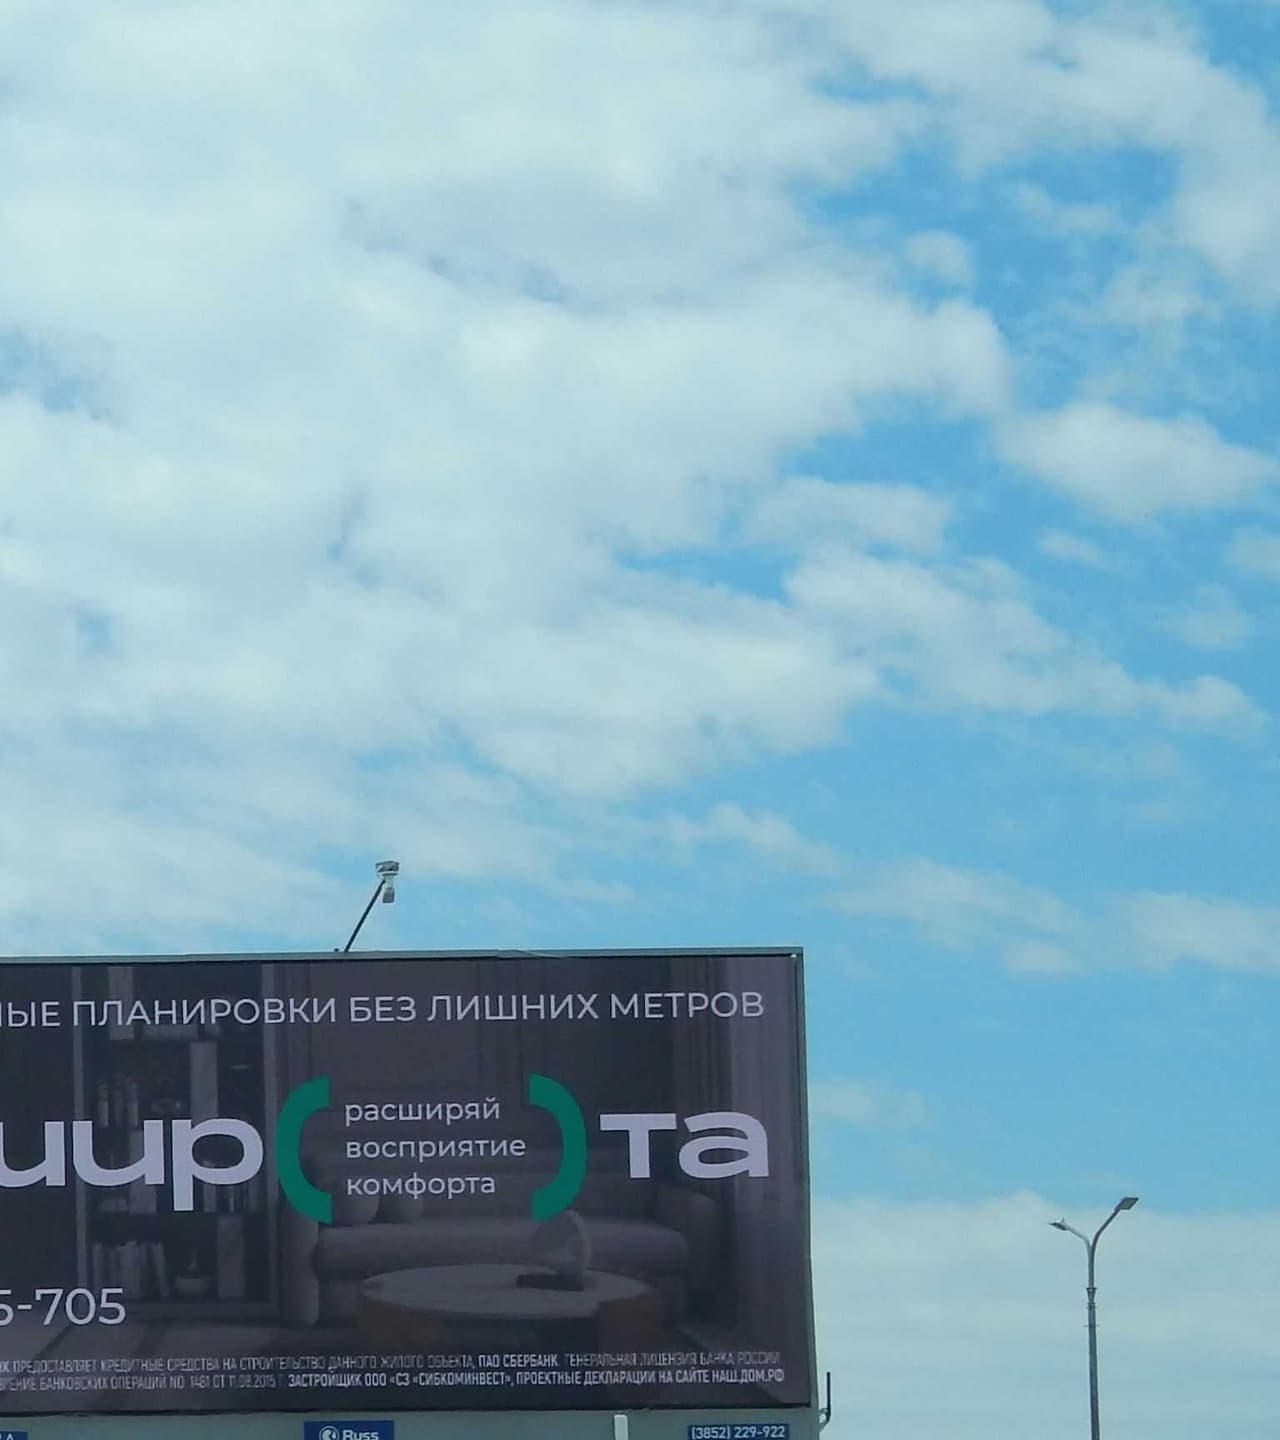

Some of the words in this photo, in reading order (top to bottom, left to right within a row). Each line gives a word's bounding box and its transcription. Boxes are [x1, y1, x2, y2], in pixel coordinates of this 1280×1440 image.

[72, 998, 336, 1026] ПЛАНИРОВКИ
[349, 996, 417, 1023] БЕЗ
[427, 993, 600, 1021] ЛИШНИХ
[610, 991, 765, 1019] МЕТРОВ
[345, 1096, 501, 1128] расширяй
[345, 1137, 527, 1163] восприятие
[346, 1172, 496, 1200] комфорта
[478, 1354, 500, 1368] ПАО
[288, 1370, 363, 1388] ЗАСТРОЙЩИК
[364, 1372, 387, 1387] ООО
[516, 1370, 582, 1386] ПРОЕКТНЫЕ
[583, 1369, 657, 1386] ДЕКЛАРАЦИИ
[658, 1369, 673, 1384] НА
[675, 1366, 710, 1384] САЙТЕ
[691, 1426, 731, 1440] (3852)
[734, 1425, 786, 1439] 229-922
